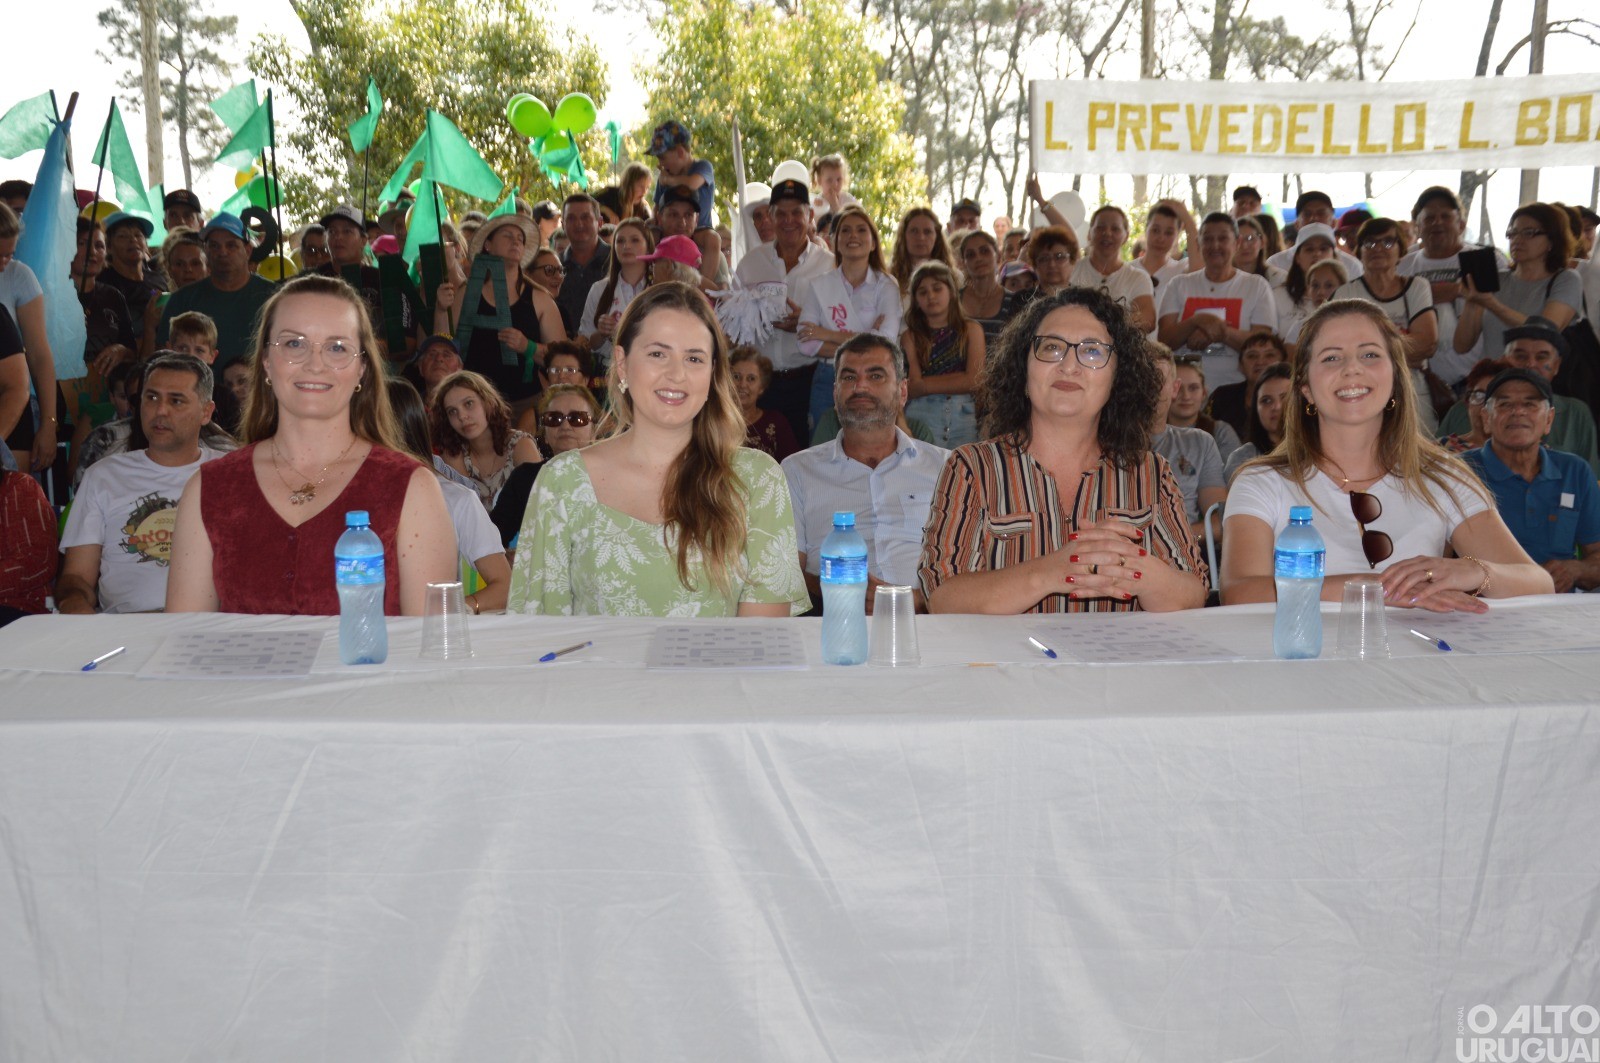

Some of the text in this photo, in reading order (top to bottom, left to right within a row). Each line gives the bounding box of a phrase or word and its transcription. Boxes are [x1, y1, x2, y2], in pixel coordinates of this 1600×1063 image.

[1044, 101, 1073, 150] L.
[1087, 101, 1427, 154] PREVEDELLO
[1458, 101, 1499, 149] L.
[1514, 94, 1600, 146] BO
